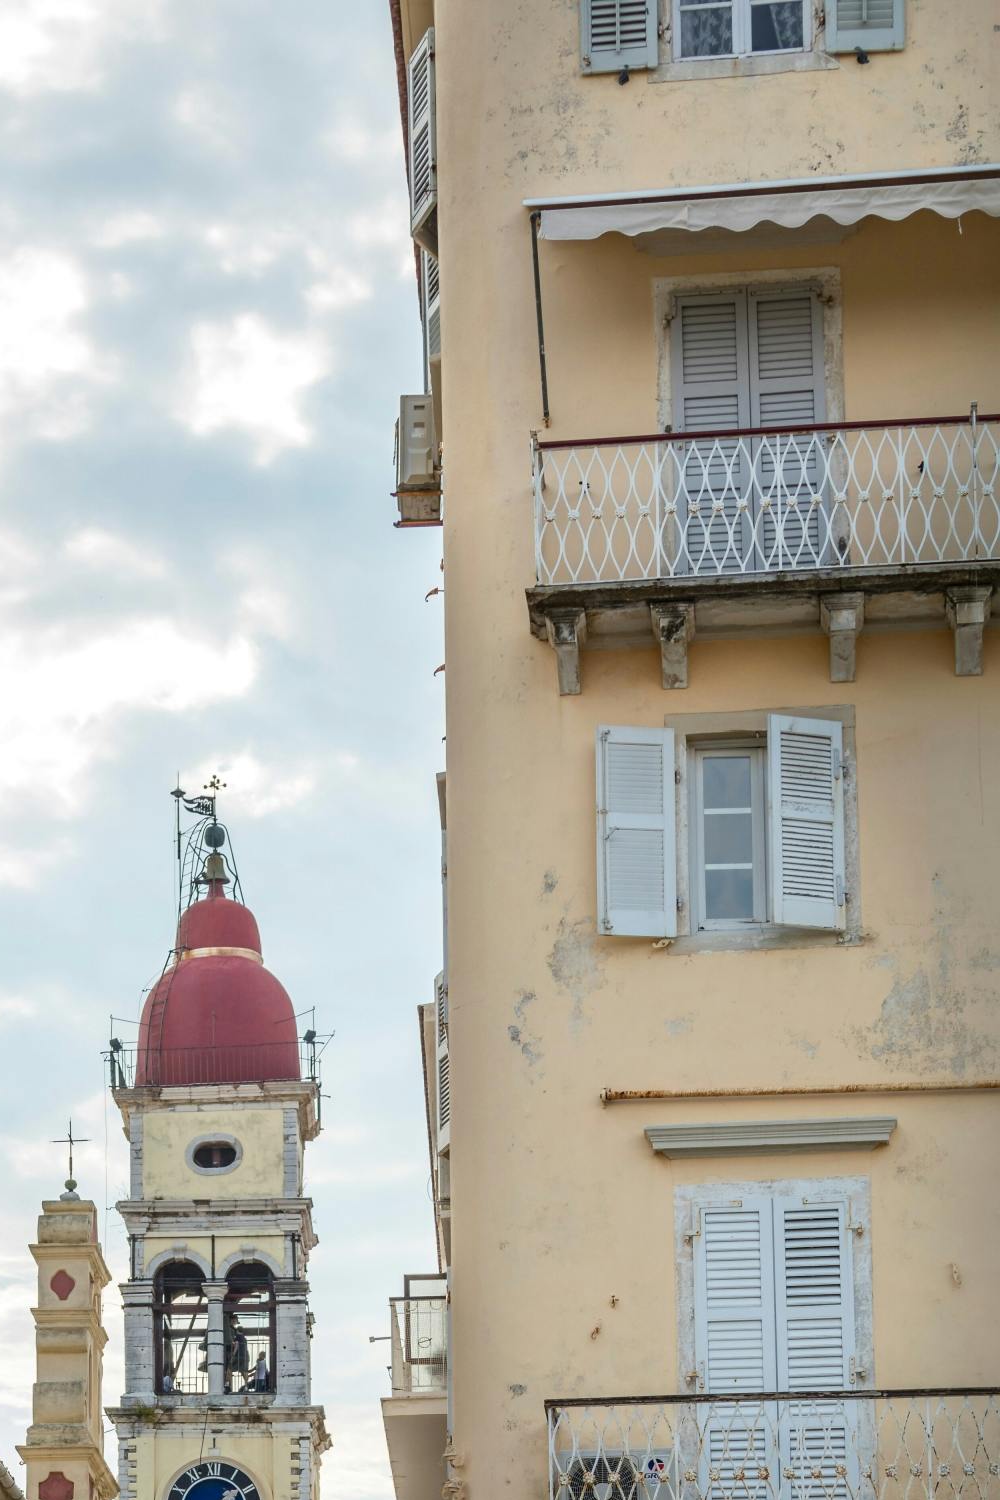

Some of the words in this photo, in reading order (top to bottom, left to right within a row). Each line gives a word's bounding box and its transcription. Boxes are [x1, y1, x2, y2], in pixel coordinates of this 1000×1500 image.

[206, 1463, 221, 1476] XII
[230, 1469, 239, 1480] I
[186, 1468, 199, 1483] XI
[173, 1485, 185, 1495] X
[242, 1483, 256, 1494] II
